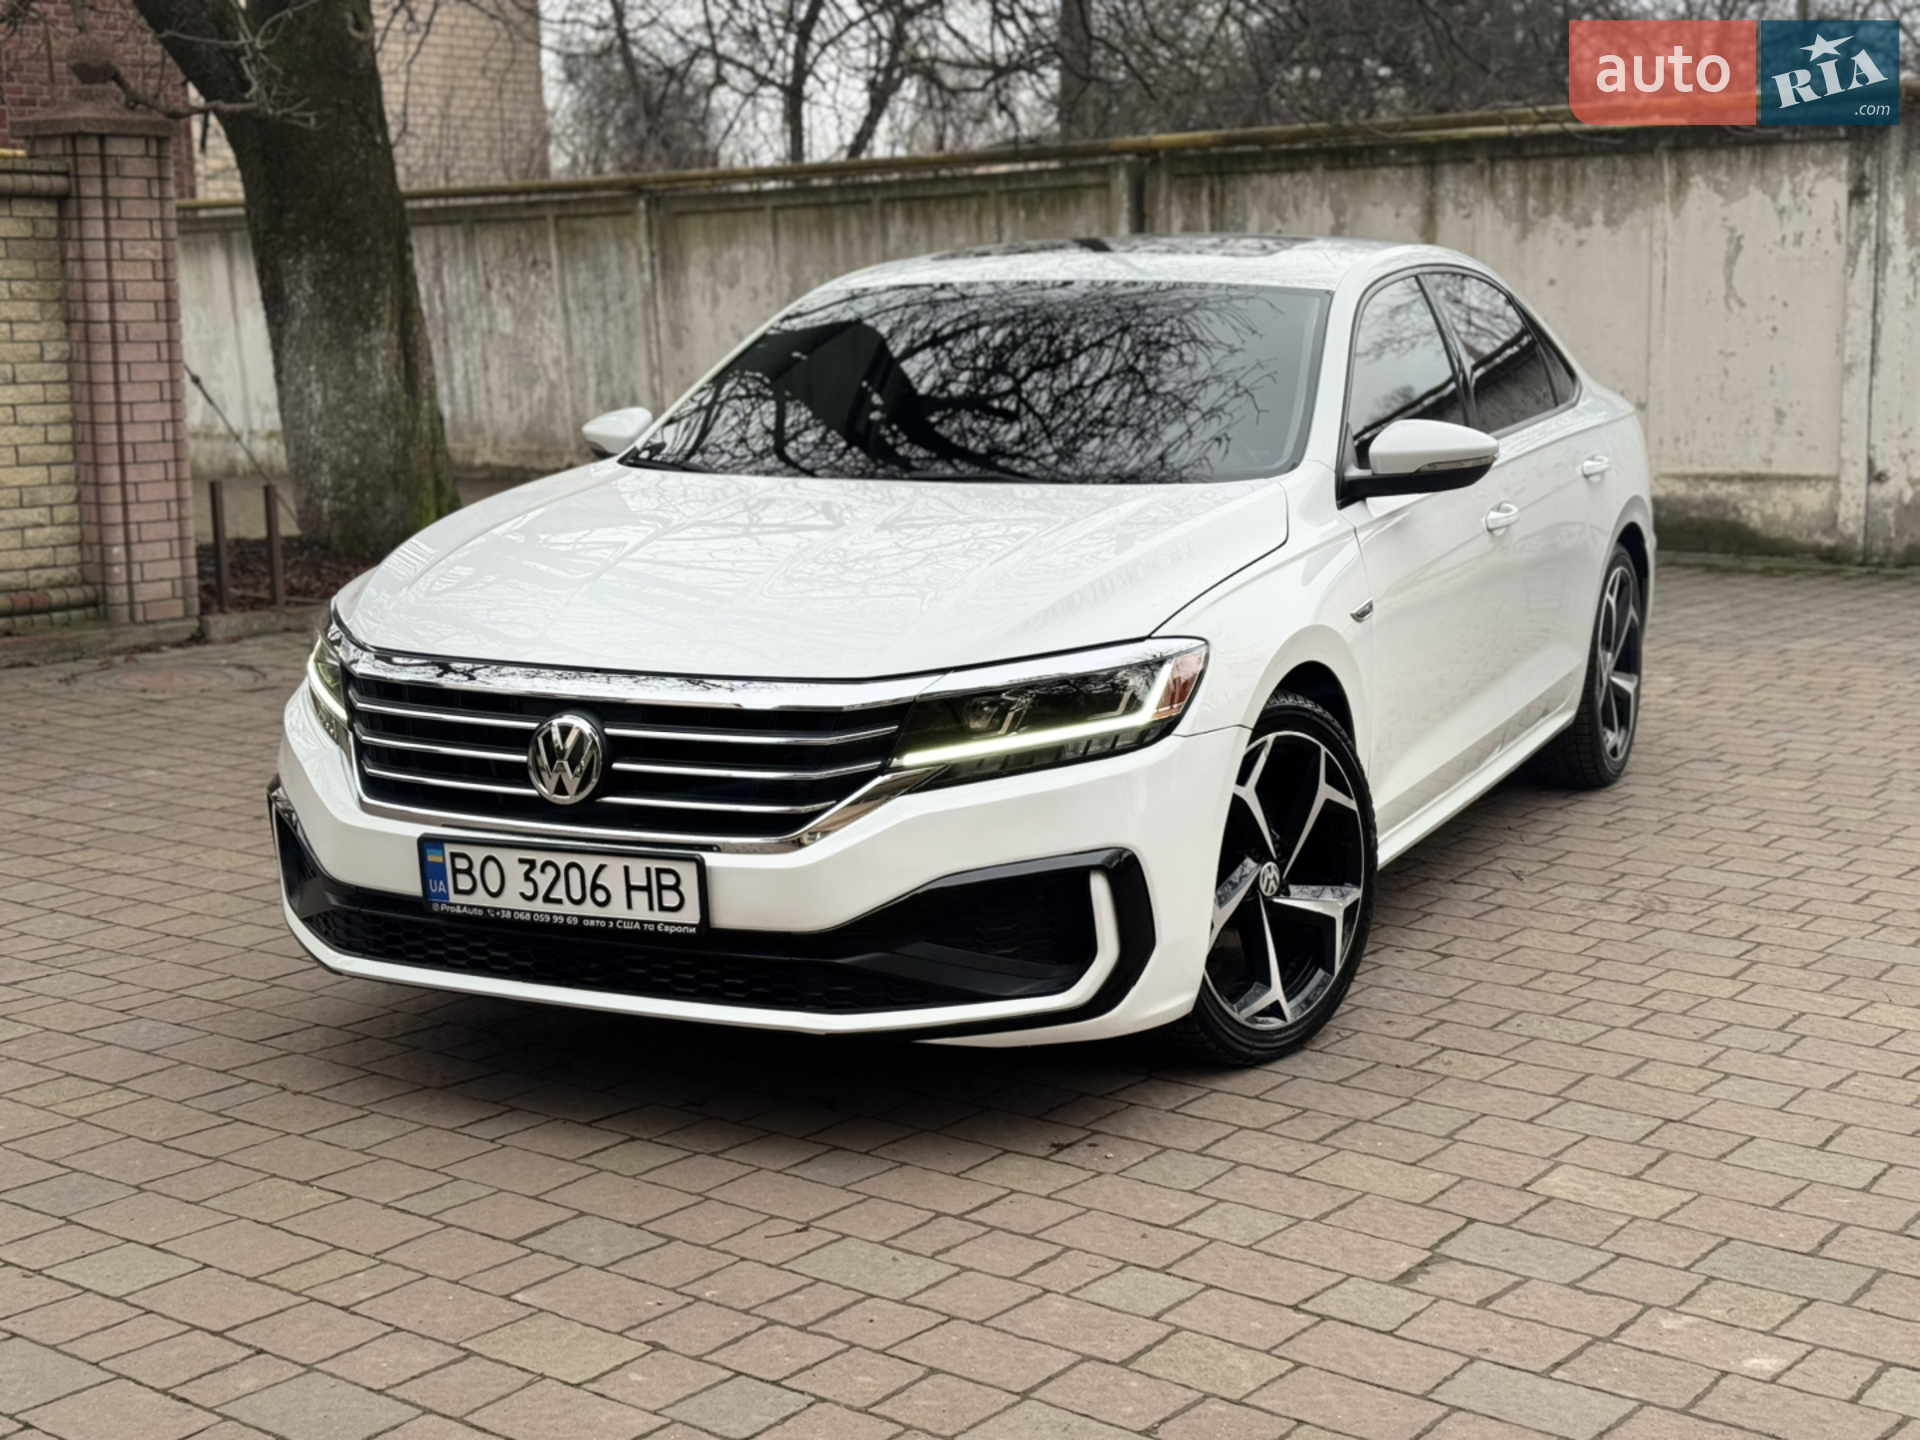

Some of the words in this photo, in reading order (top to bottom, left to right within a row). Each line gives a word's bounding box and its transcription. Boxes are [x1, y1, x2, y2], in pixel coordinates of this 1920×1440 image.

[429, 879, 447, 894] UA
[518, 858, 612, 908] 3206
[496, 910, 511, 919] +38
[513, 911, 530, 921] 068
[533, 913, 550, 923] 059
[552, 915, 564, 924] 99
[566, 916, 578, 925] 69
[616, 920, 640, 930] США
